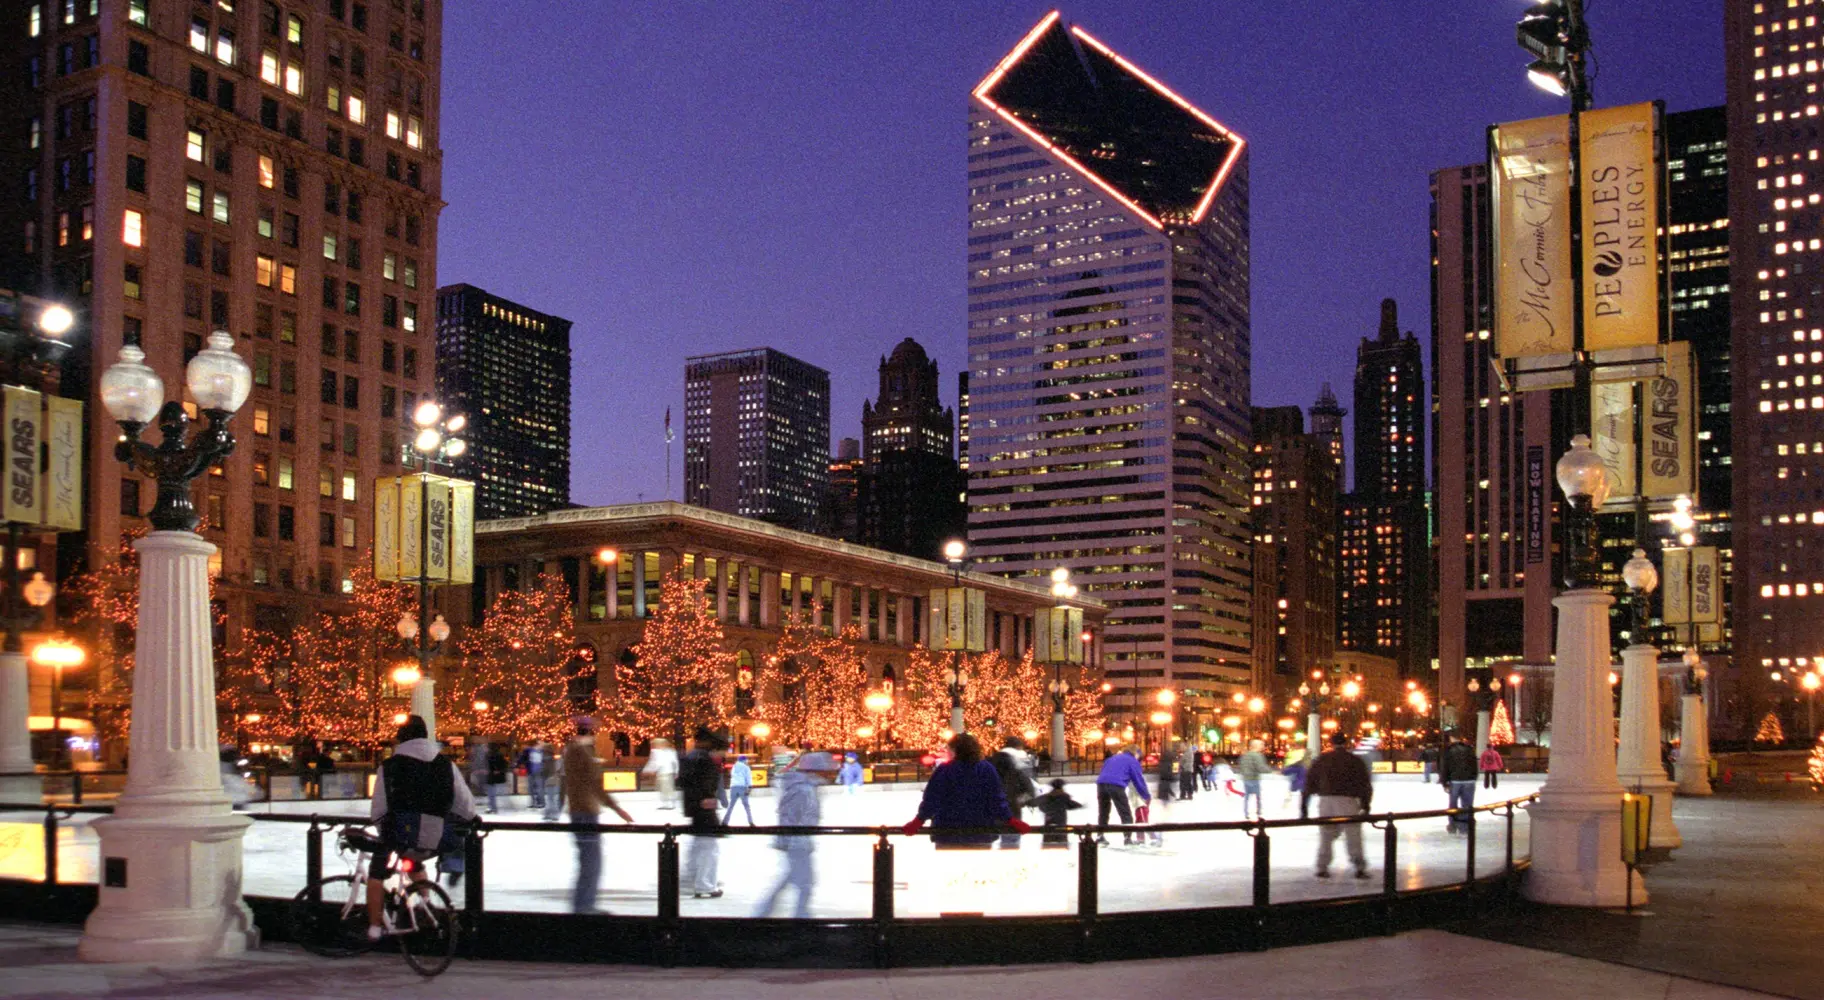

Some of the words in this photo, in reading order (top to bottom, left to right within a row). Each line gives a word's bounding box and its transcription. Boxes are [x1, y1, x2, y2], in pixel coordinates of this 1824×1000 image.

[1516, 158, 1553, 209] Tribue
[1520, 210, 1554, 337] McCormick
[1592, 165, 1623, 318] PEOPLES
[11, 418, 34, 508] SEARS
[1651, 377, 1680, 478] SEARS
[1529, 462, 1541, 487] NOW
[430, 499, 445, 568] SEARS
[1696, 564, 1711, 614] SEARS
